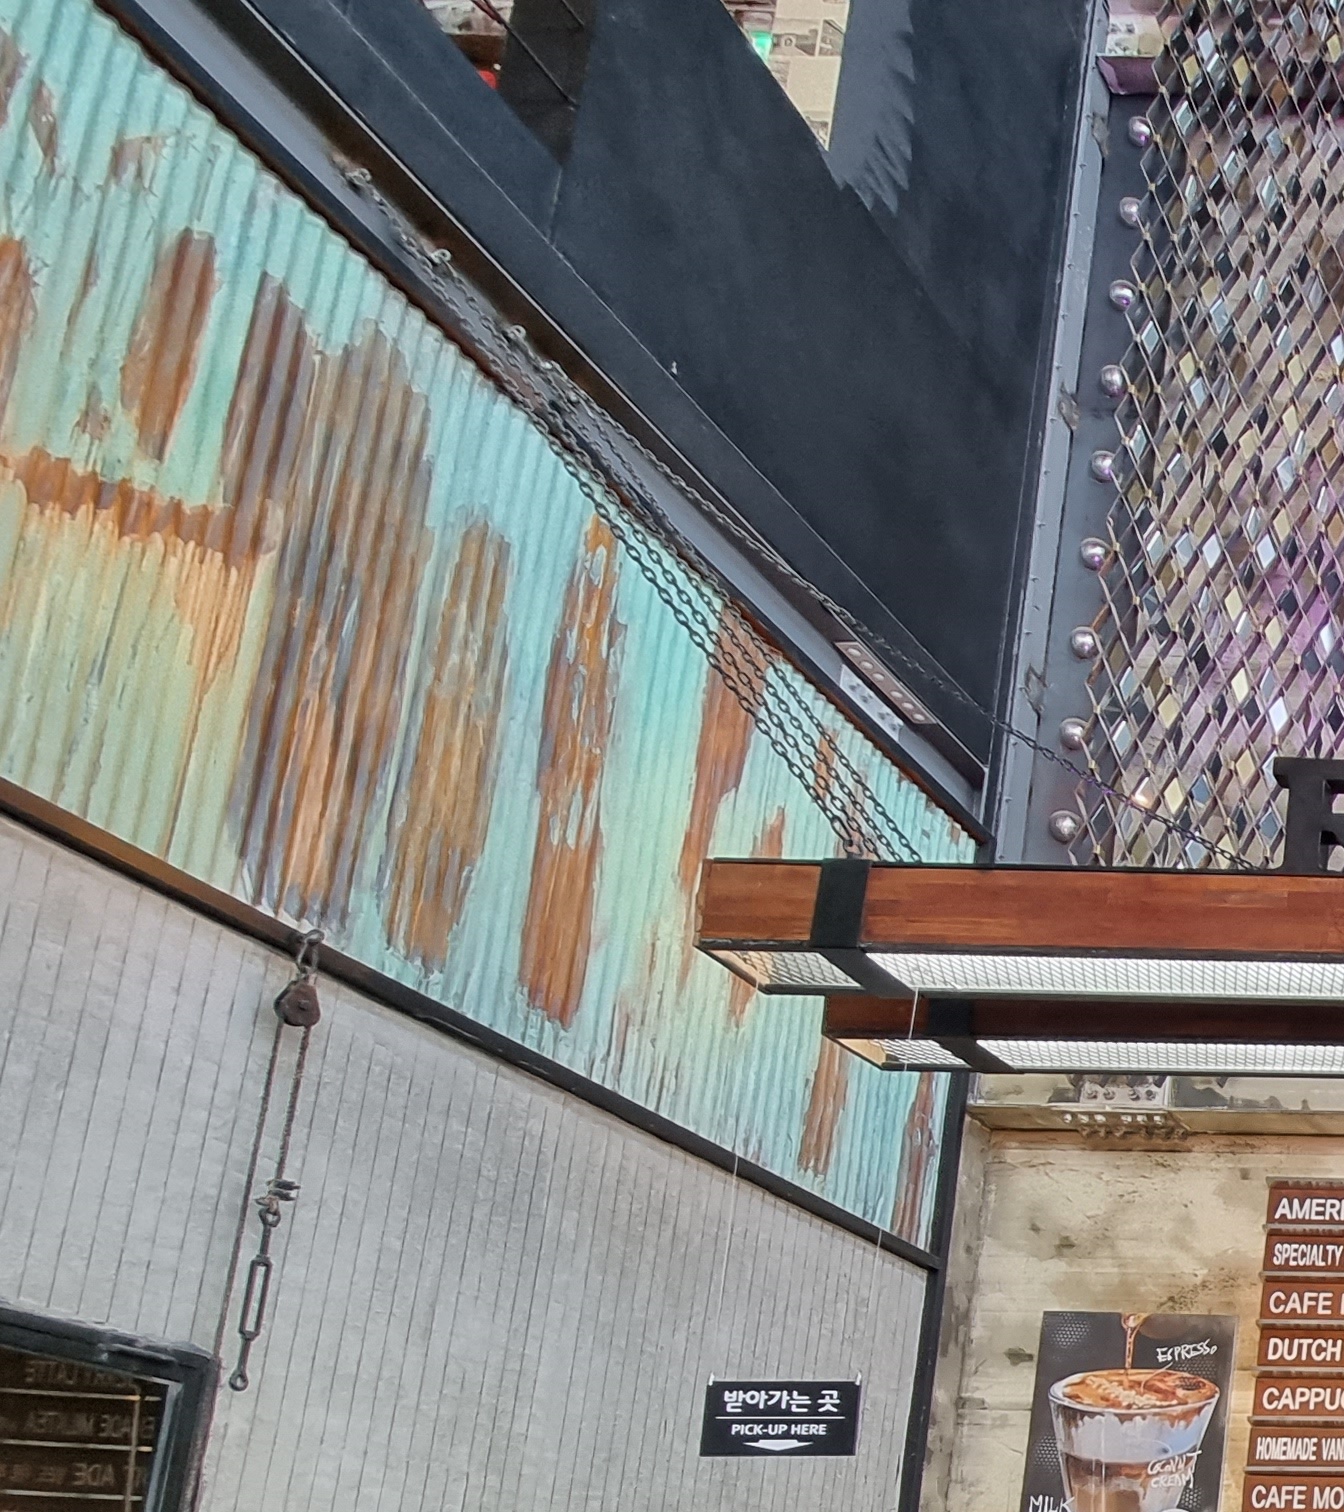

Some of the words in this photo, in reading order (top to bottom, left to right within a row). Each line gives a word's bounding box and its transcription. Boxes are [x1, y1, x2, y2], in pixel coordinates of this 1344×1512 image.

[1273, 1244, 1343, 1267] SPECIALTY
[1269, 1292, 1333, 1315] CAFE
[1267, 1338, 1342, 1361] DUTCH
[724, 1391, 811, 1412] 받아가는
[818, 1391, 840, 1412] 곳
[731, 1424, 788, 1435] PICK-UP
[791, 1425, 827, 1435] HERE
[1251, 1486, 1306, 1509] CAFE
